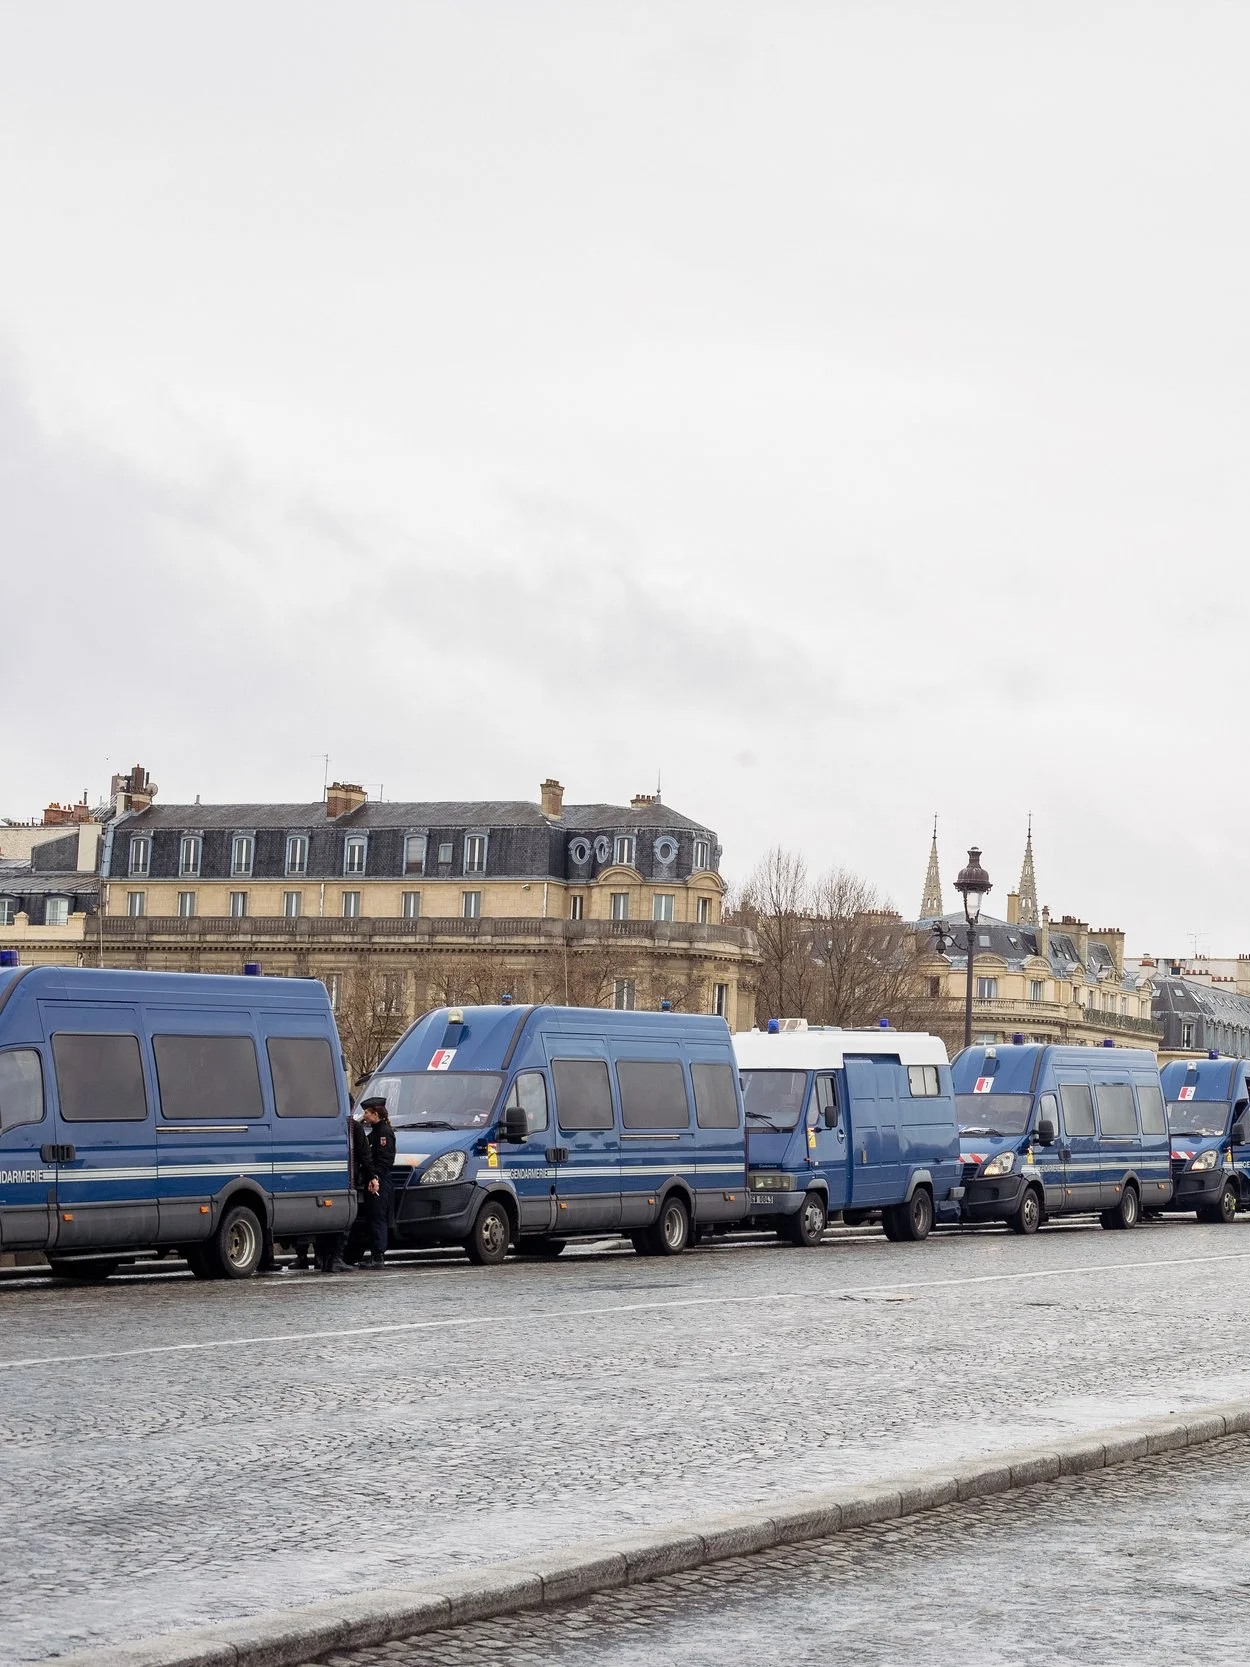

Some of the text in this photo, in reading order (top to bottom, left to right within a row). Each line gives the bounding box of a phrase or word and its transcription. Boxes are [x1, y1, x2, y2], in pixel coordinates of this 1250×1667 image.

[441, 1054, 450, 1064] 2
[0, 1170, 43, 1184] DARMERIE
[510, 1168, 548, 1179] GENDARMERIE
